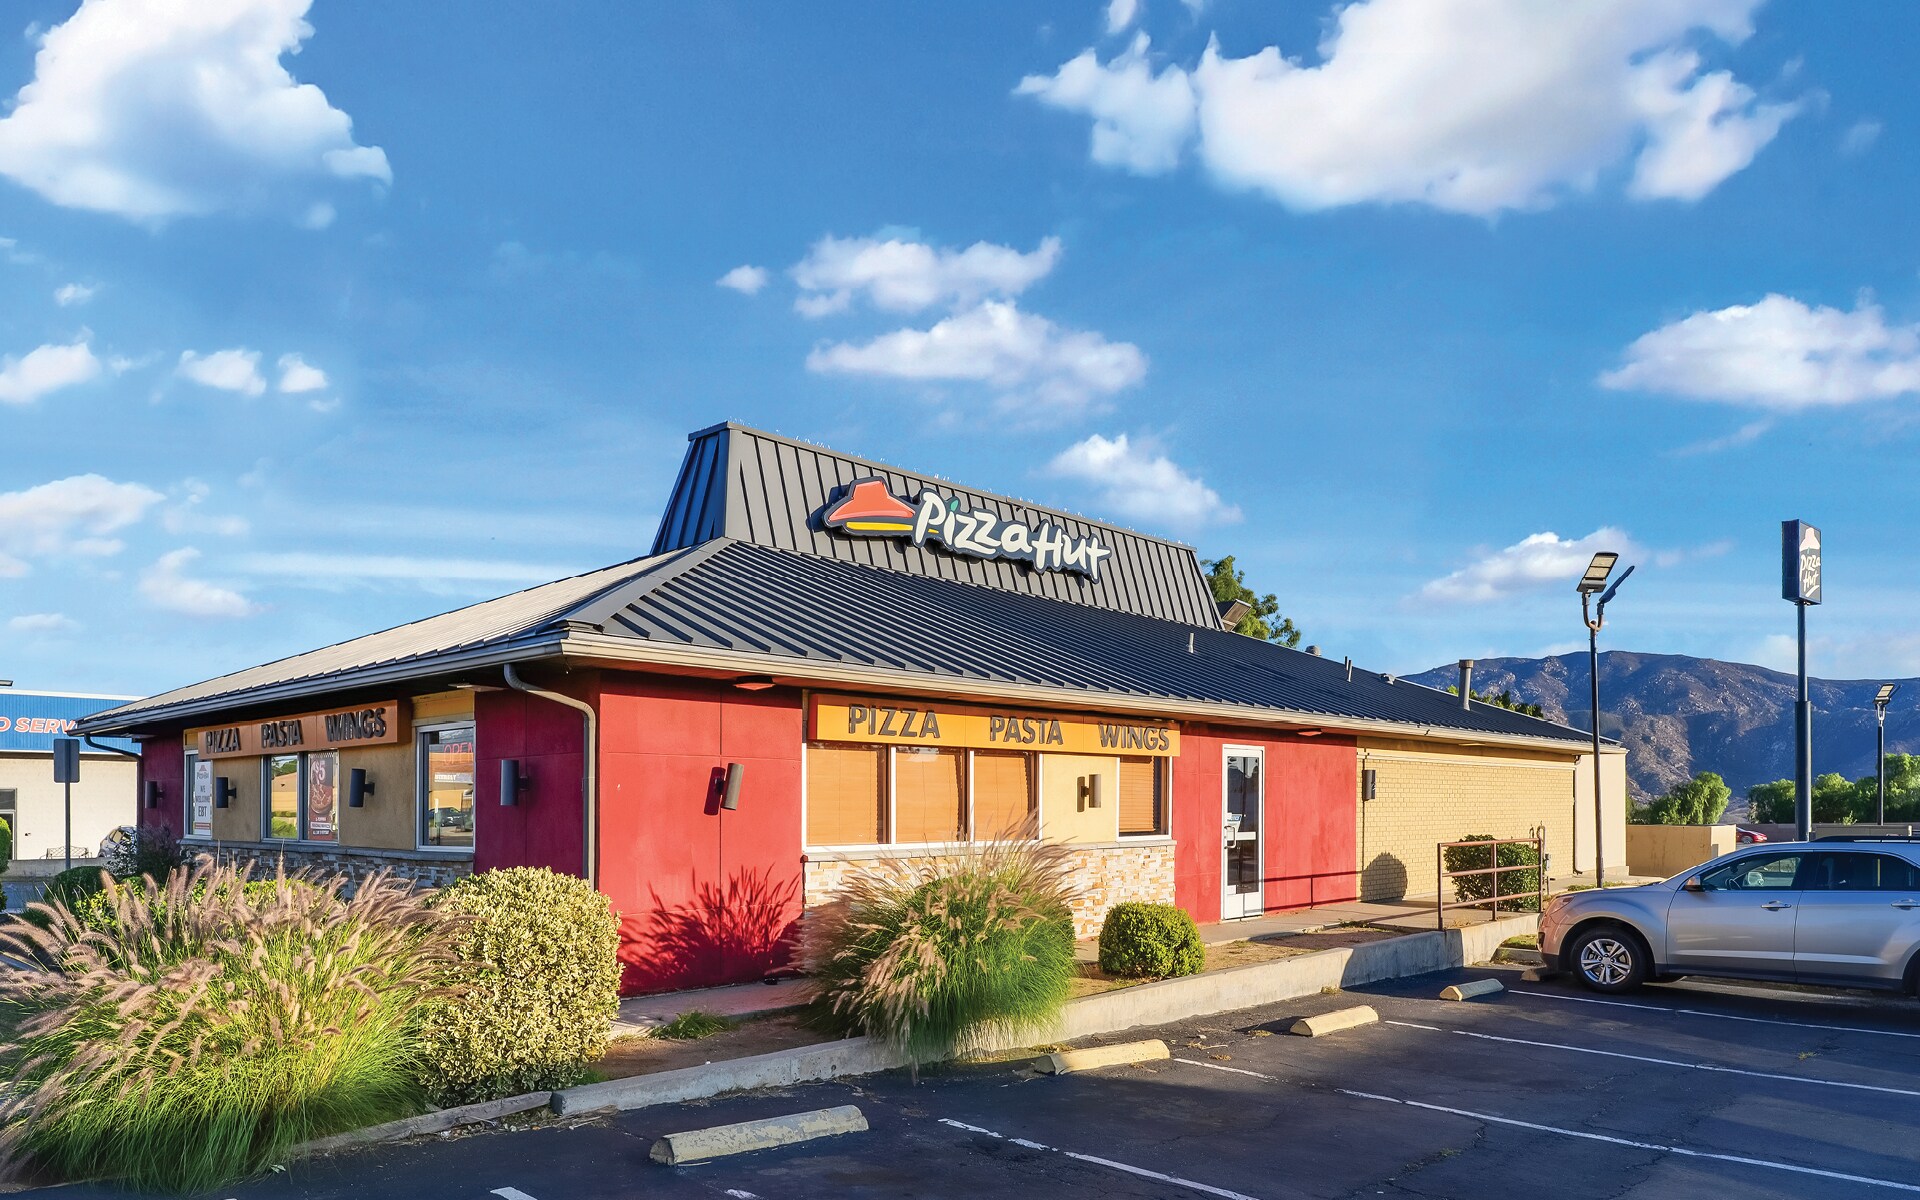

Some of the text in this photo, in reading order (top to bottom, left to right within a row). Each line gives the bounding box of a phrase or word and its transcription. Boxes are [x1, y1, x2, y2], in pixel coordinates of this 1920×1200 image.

[915, 490, 1111, 582] Pizza Hut
[1800, 550, 1821, 582] Pizza
[1803, 570, 1819, 592] Hut
[14, 717, 78, 734] SERV
[205, 707, 387, 754] PIZZA PASTA WINGS
[848, 703, 1171, 751] PIZZA PASTA WINGS
[444, 742, 473, 765] OPEN
[198, 806, 207, 817] EBT
